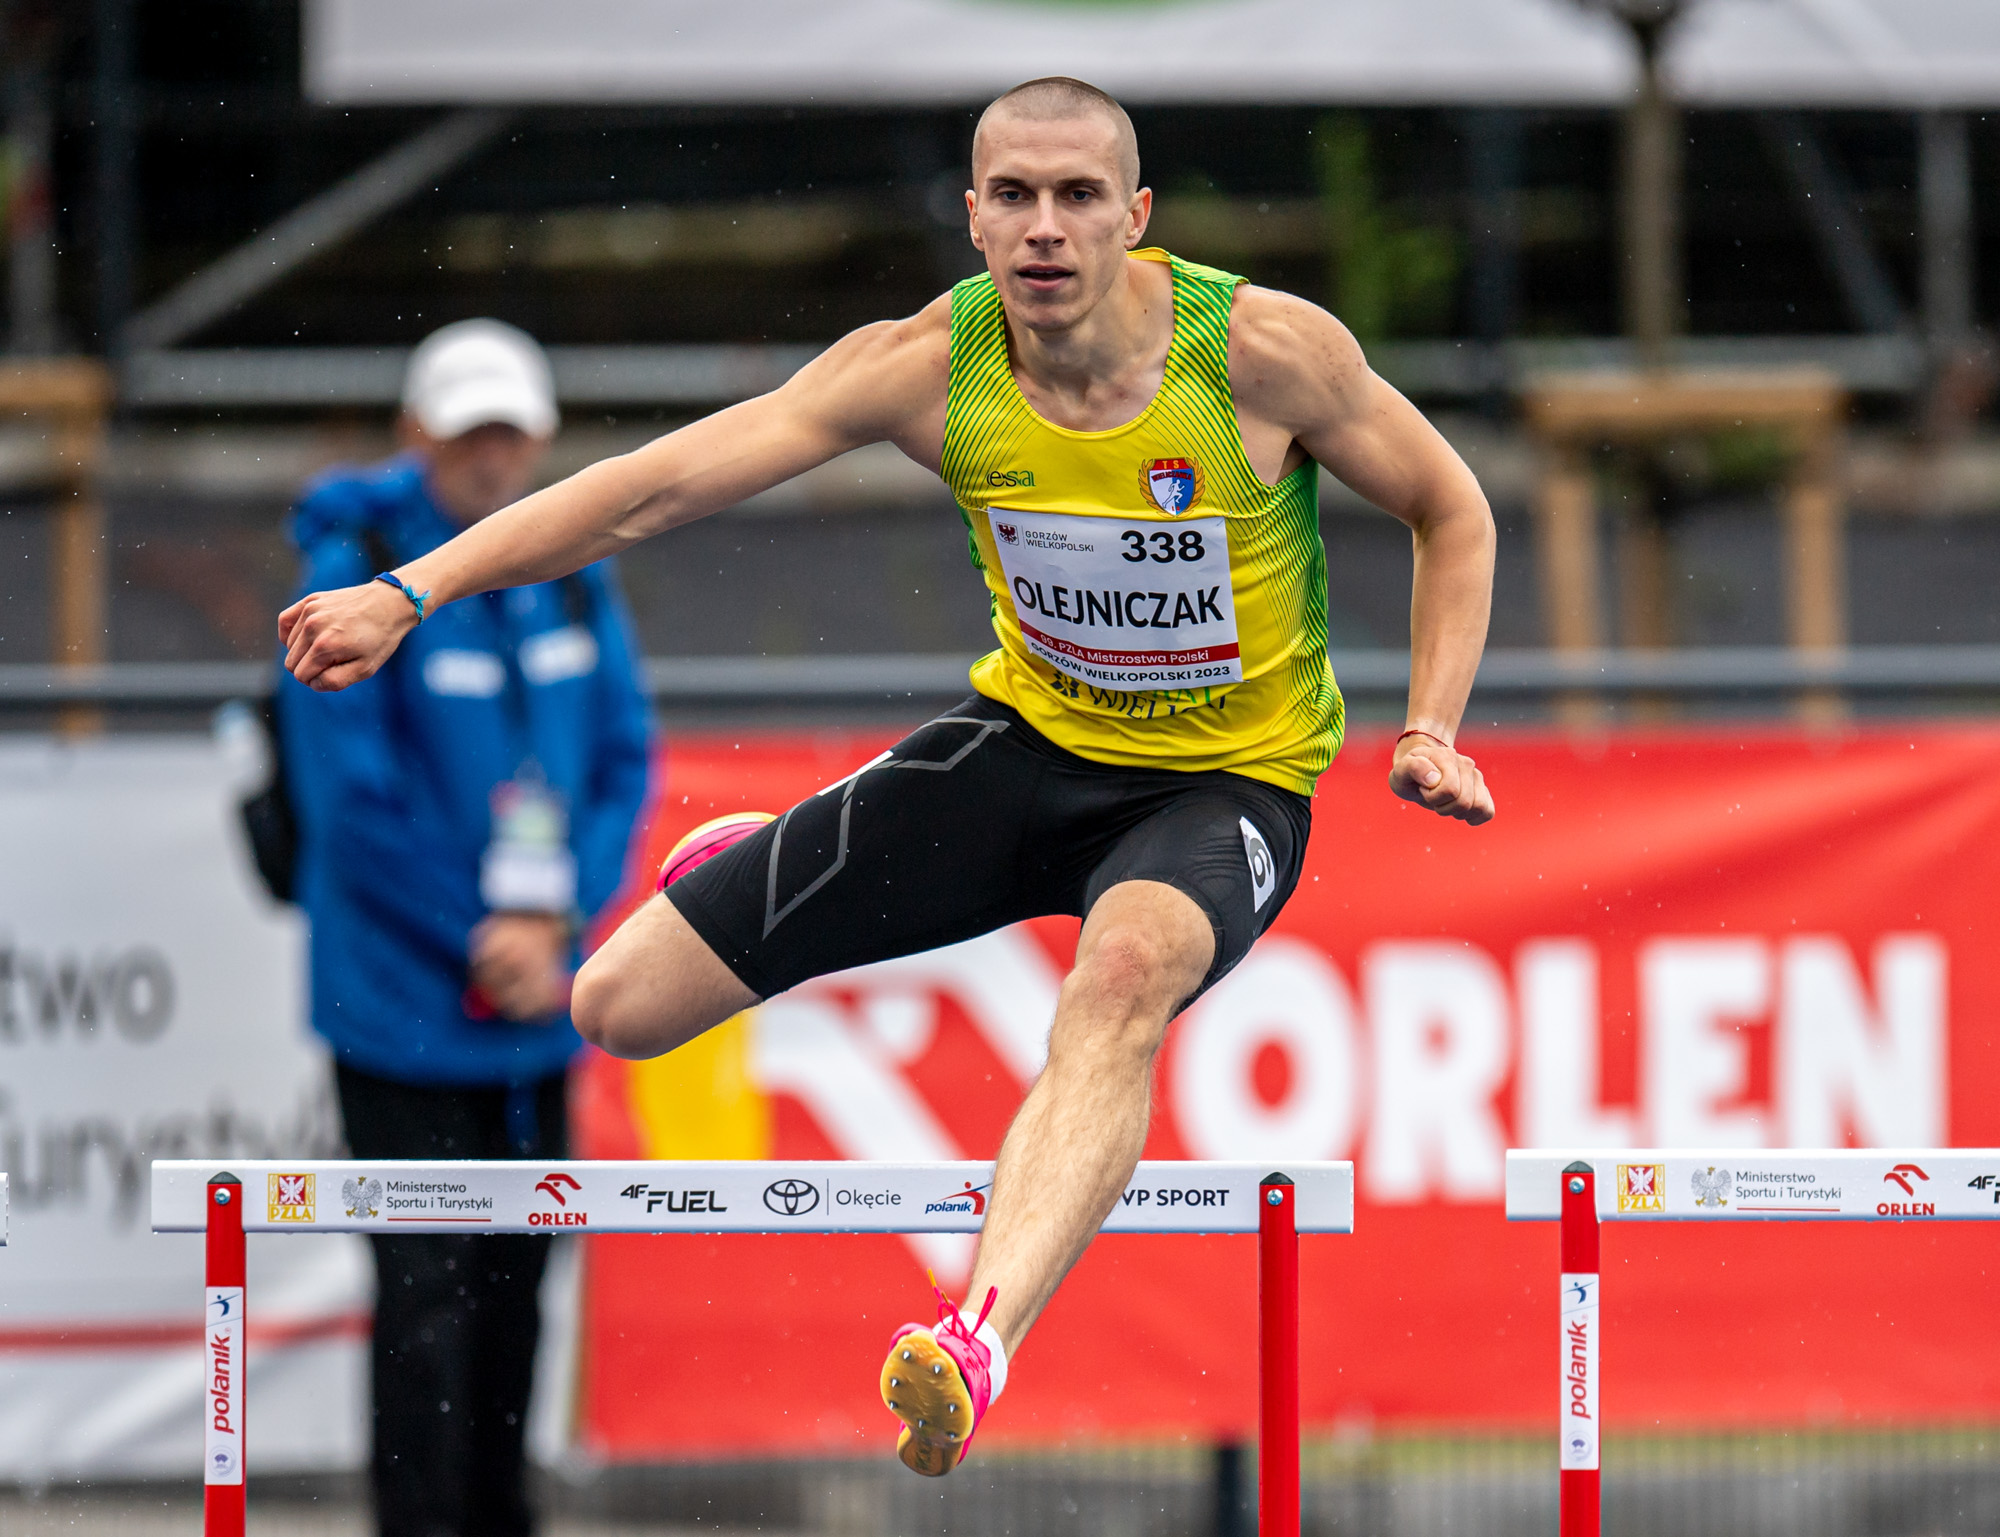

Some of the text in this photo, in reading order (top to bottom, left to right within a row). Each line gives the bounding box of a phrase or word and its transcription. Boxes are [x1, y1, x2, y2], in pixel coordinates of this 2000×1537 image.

[987, 470, 1036, 487] esa
[1025, 530, 1068, 542] GORZÓW
[1026, 539, 1095, 553] WIELKOPOLSKI
[1120, 530, 1206, 563] 338
[1013, 575, 1225, 629] OLEJNICZAK
[1059, 642, 1085, 659] PZLA
[1087, 652, 1167, 664] Mistrzostwa
[1170, 649, 1209, 663] Polski
[1031, 642, 1230, 682] GORZÓW WIELKOPOLSKI 2023
[1172, 934, 1948, 1200] ORLEN
[1736, 1171, 1816, 1183] Ministerstwo
[1967, 1175, 1997, 1190] 4F
[387, 1181, 467, 1193] Ministerstwo
[1736, 1187, 1842, 1200] Sportu i Turystyki
[386, 1197, 493, 1210] Sportu i Turystyki
[620, 1184, 728, 1213] 4F FUEL
[836, 1189, 902, 1209] Okęcie
[1120, 1189, 1230, 1206] VP SPORT
[1621, 1197, 1662, 1210] PZLA
[271, 1207, 312, 1220] PZLA
[925, 1201, 973, 1214] polanik
[1876, 1203, 1935, 1216] ORLEN
[528, 1213, 587, 1226] ORLEN
[1567, 1320, 1592, 1420] polanik
[210, 1333, 236, 1435] polanik
